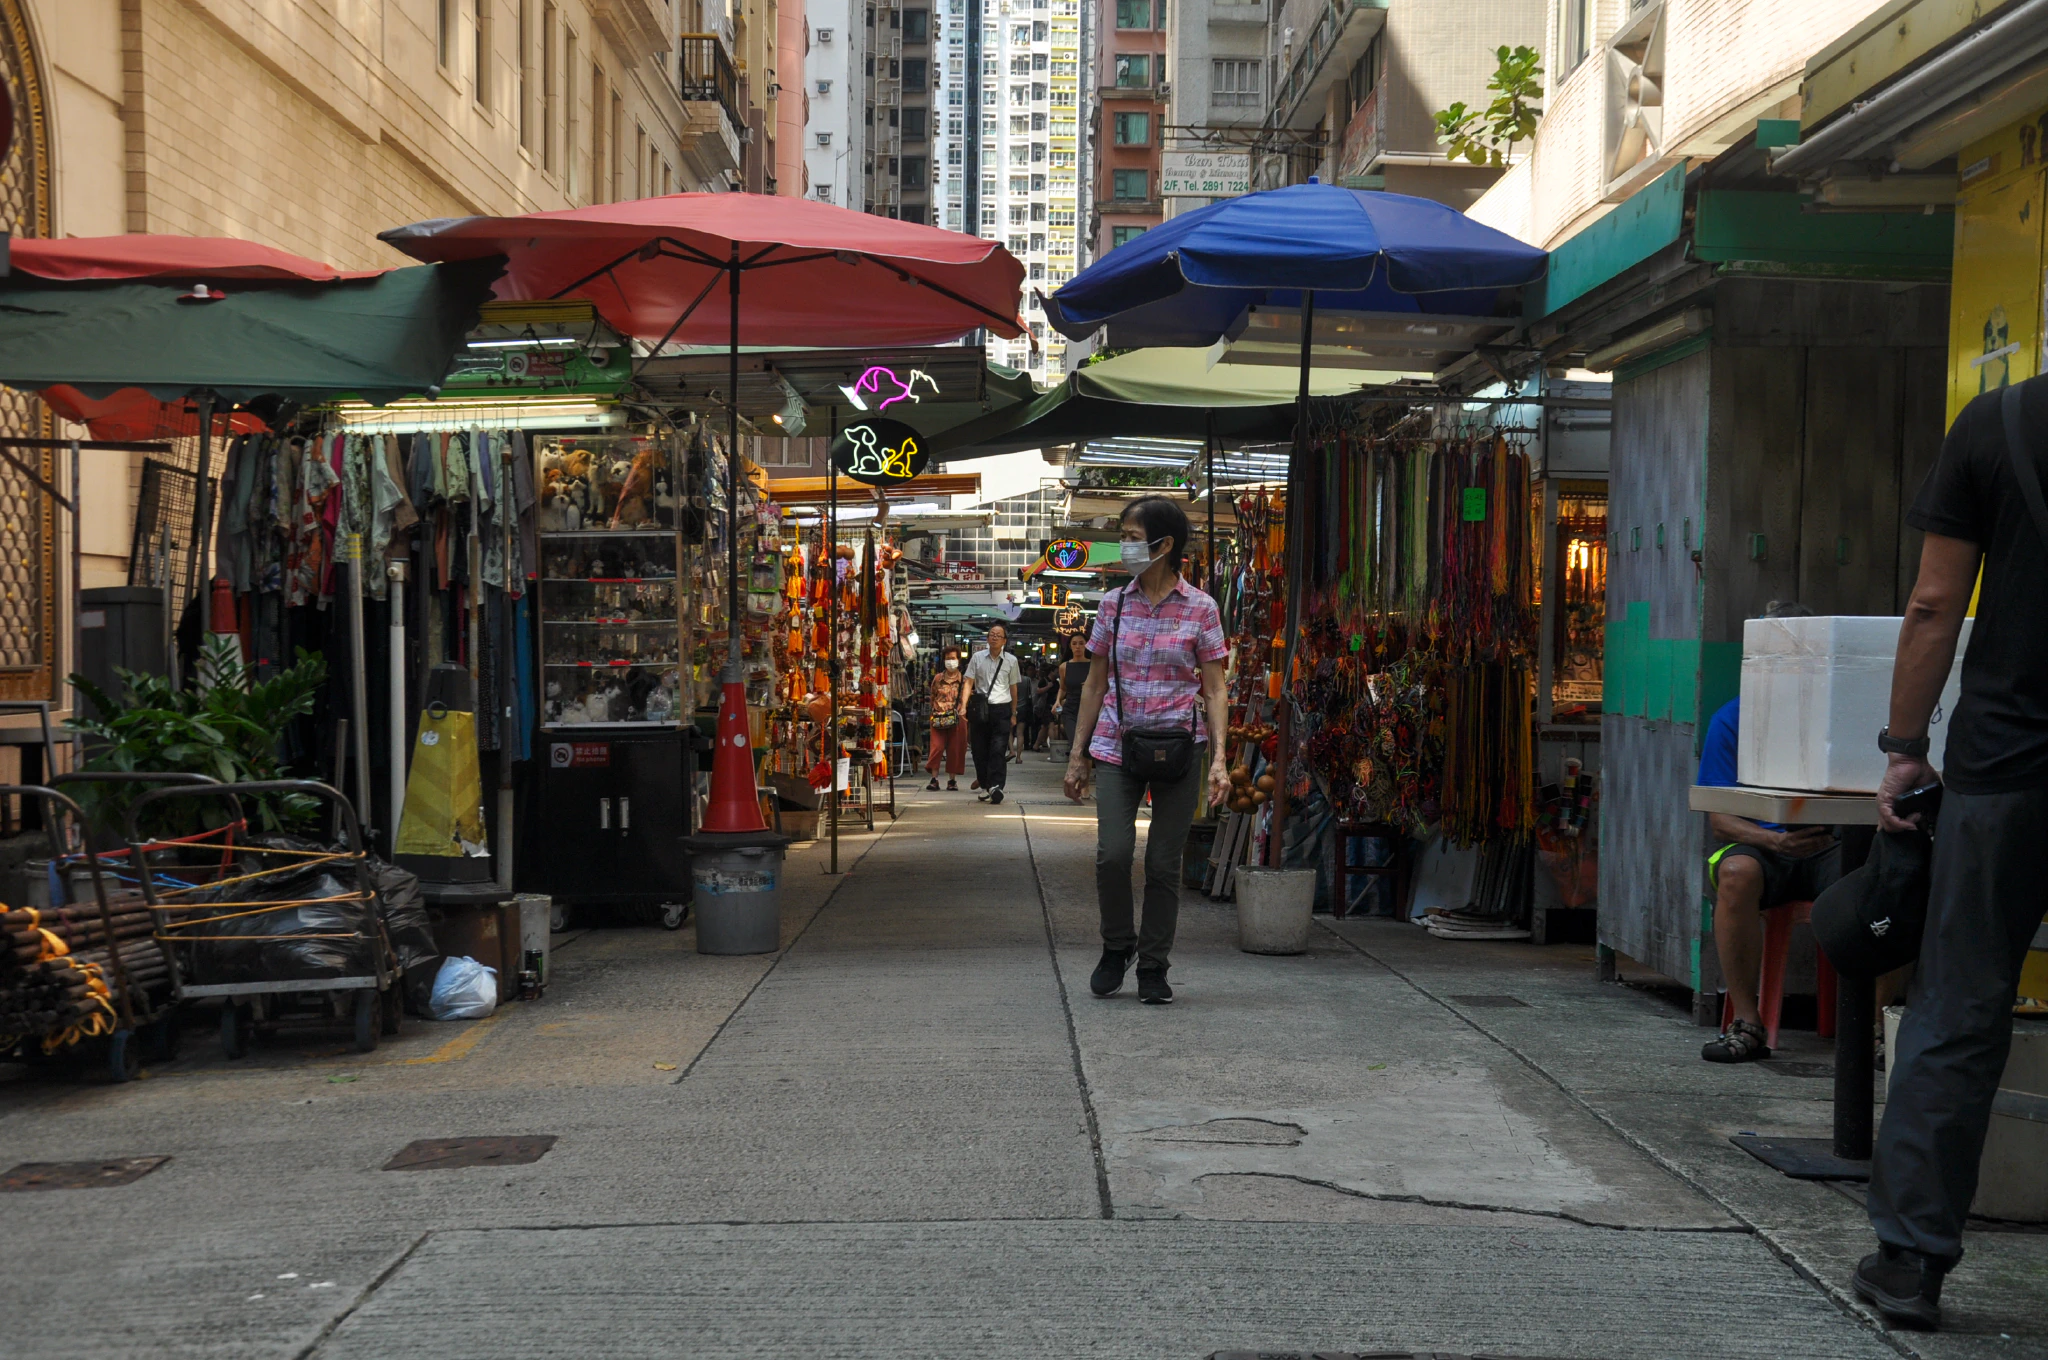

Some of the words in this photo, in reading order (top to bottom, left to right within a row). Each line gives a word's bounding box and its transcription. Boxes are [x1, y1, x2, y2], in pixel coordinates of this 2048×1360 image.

[1184, 154, 1212, 167] Ban
[1217, 155, 1249, 168] Thai
[1165, 167, 1196, 179] Beauty
[1209, 169, 1248, 179] Massage
[1164, 180, 1180, 192] 2/F,
[1184, 181, 1200, 191] Tel.
[1202, 181, 1224, 191] 2891
[1228, 181, 1249, 192] 7224
